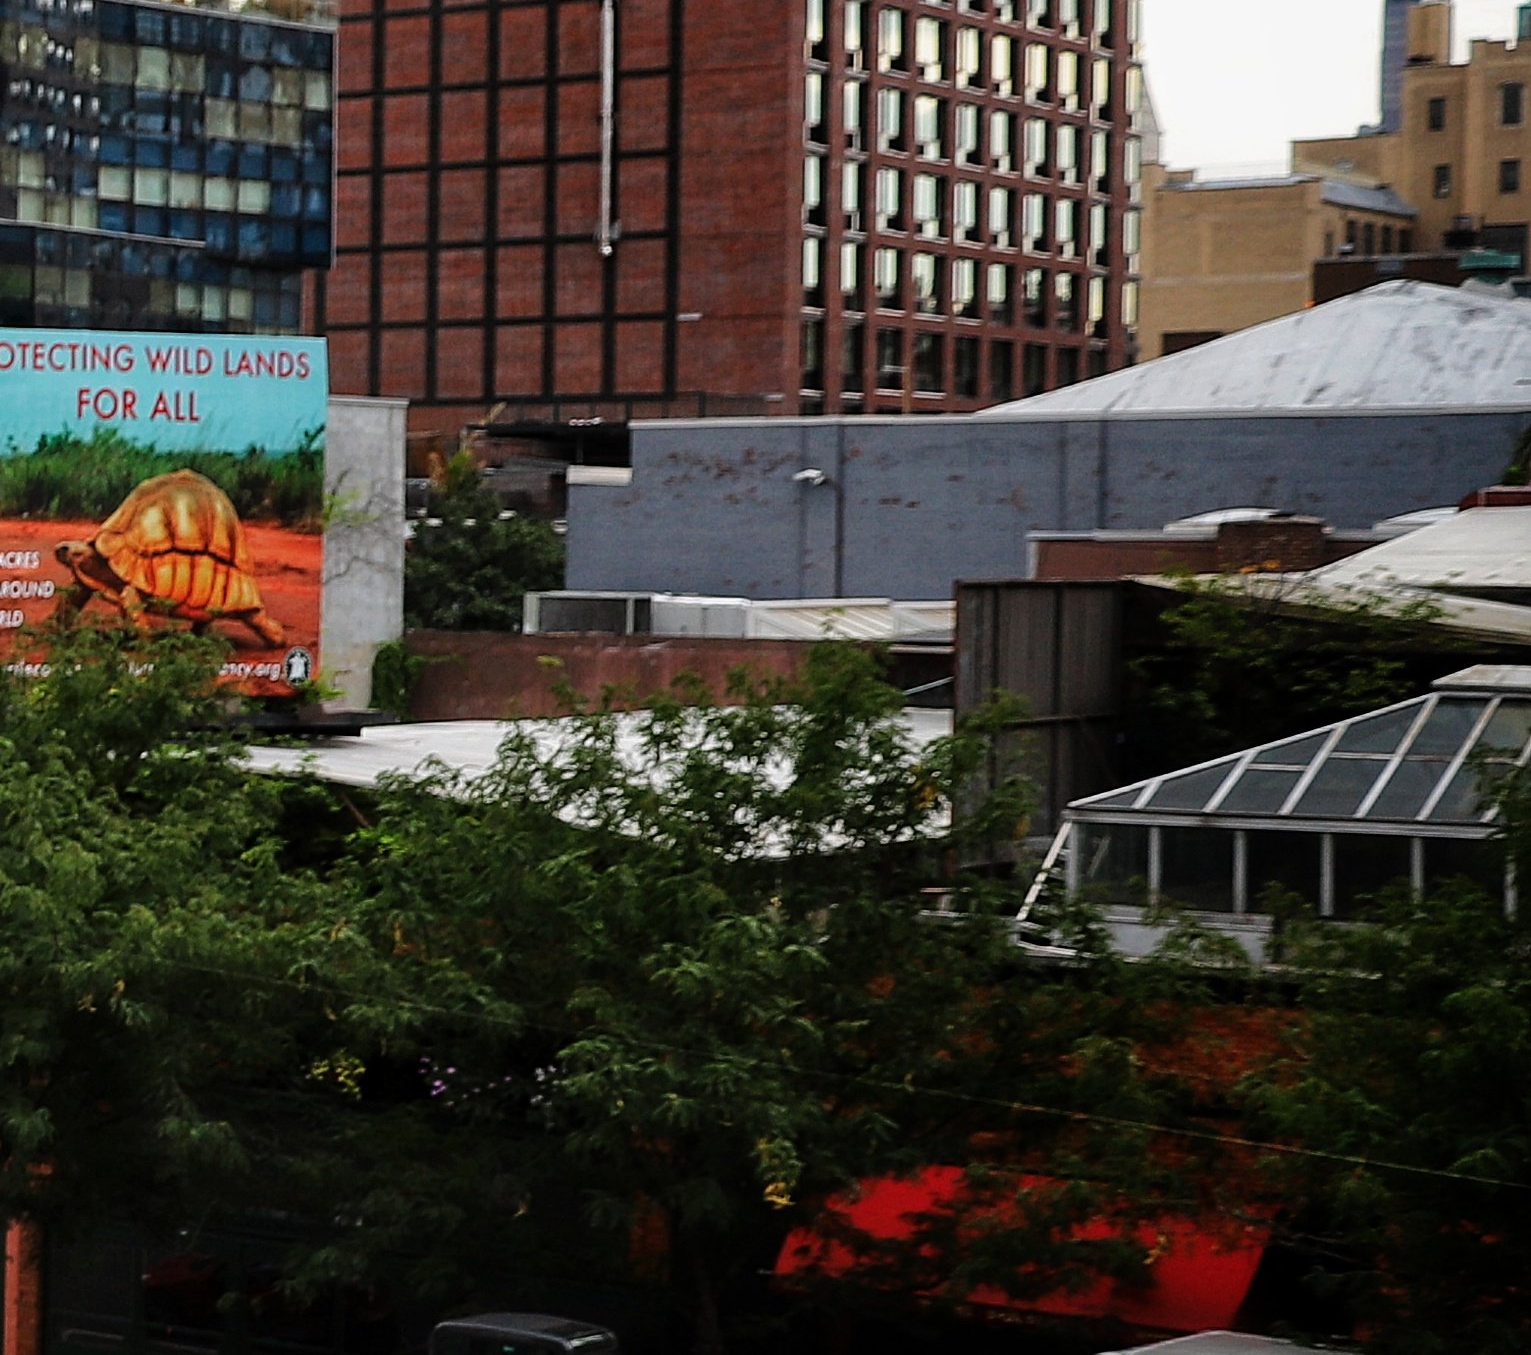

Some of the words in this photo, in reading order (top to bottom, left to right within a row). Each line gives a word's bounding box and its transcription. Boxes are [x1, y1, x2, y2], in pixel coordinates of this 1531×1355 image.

[145, 347, 214, 375] WILD
[223, 348, 311, 379] LANDS
[77, 387, 138, 421] FOR
[149, 391, 202, 422] ALL
